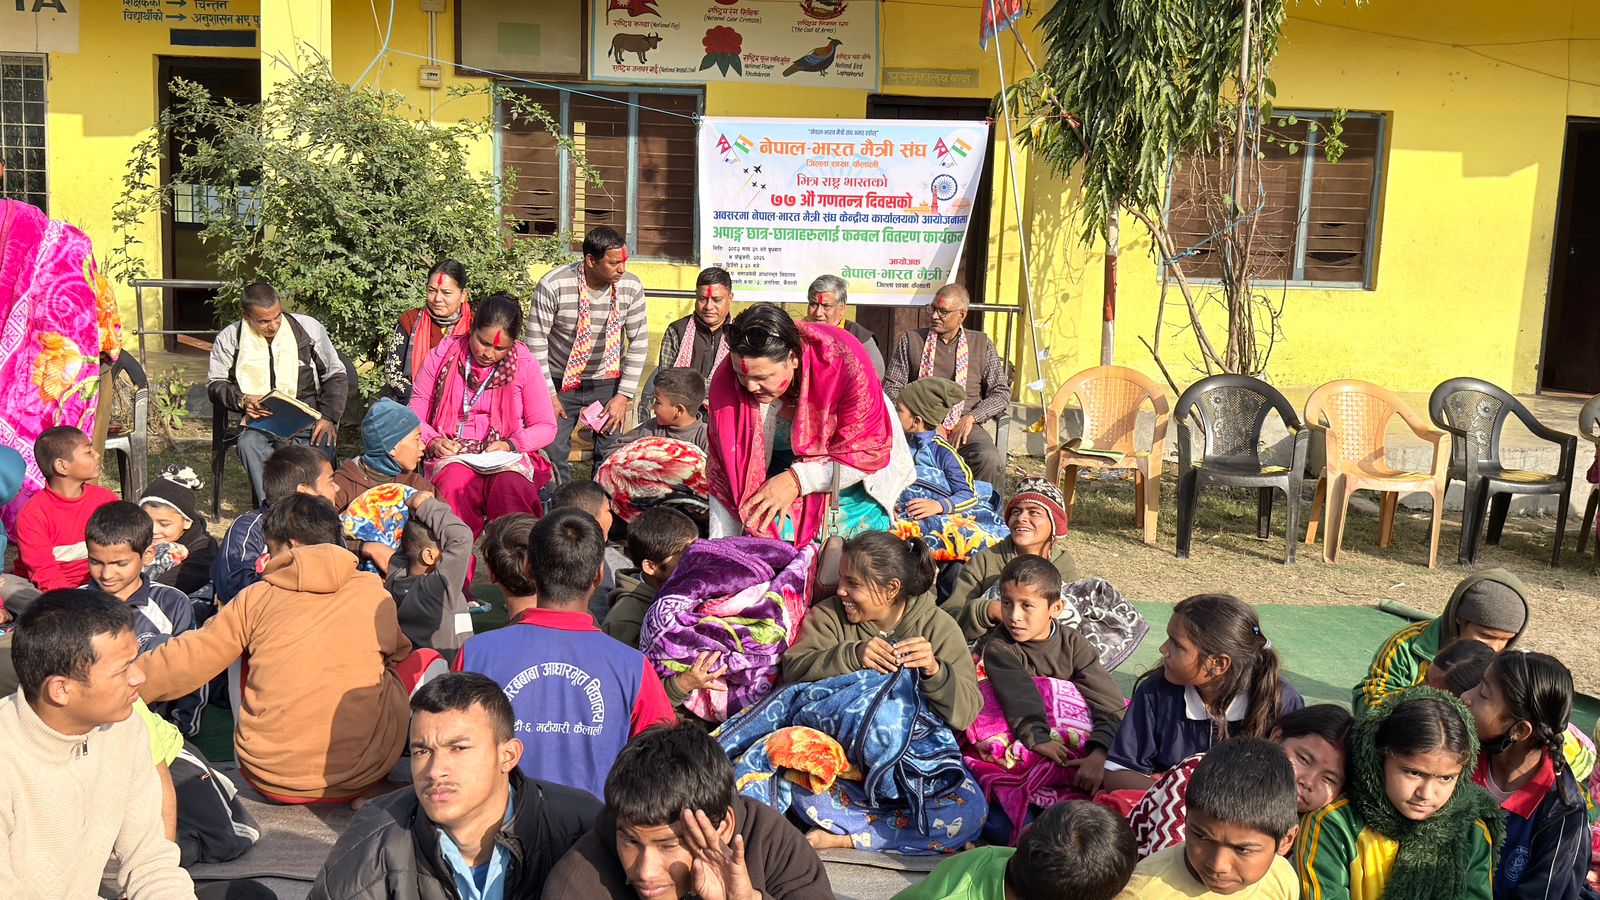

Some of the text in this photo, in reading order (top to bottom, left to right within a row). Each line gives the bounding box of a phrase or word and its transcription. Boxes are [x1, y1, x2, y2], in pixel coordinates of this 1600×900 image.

[192, 13, 233, 28] अनुशासन
[759, 137, 928, 158] नेपाल-भारत मैत्री संघ
[797, 173, 888, 190] मित्र राष्ट्र भारतको
[771, 194, 796, 207] ७७
[817, 194, 864, 208] गणतन्त्र
[865, 192, 913, 208] दिवसको
[713, 210, 749, 220] अवसरमा
[752, 209, 800, 222] नेपाल-भारत
[803, 210, 820, 222] मैत्री
[823, 212, 836, 222] संघ
[839, 211, 869, 224] केन्द्रीय
[871, 212, 919, 224] कार्यालयको
[842, 229, 880, 242] कम्बल
[882, 226, 921, 243] वितरण
[889, 257, 920, 266] आयोजक
[841, 265, 914, 280] नेपाल-भारत
[917, 266, 943, 280] मैत्री
[541, 662, 590, 687] आधारभूत
[583, 678, 605, 723] विद्यालय
[573, 721, 603, 736] कैलाली
